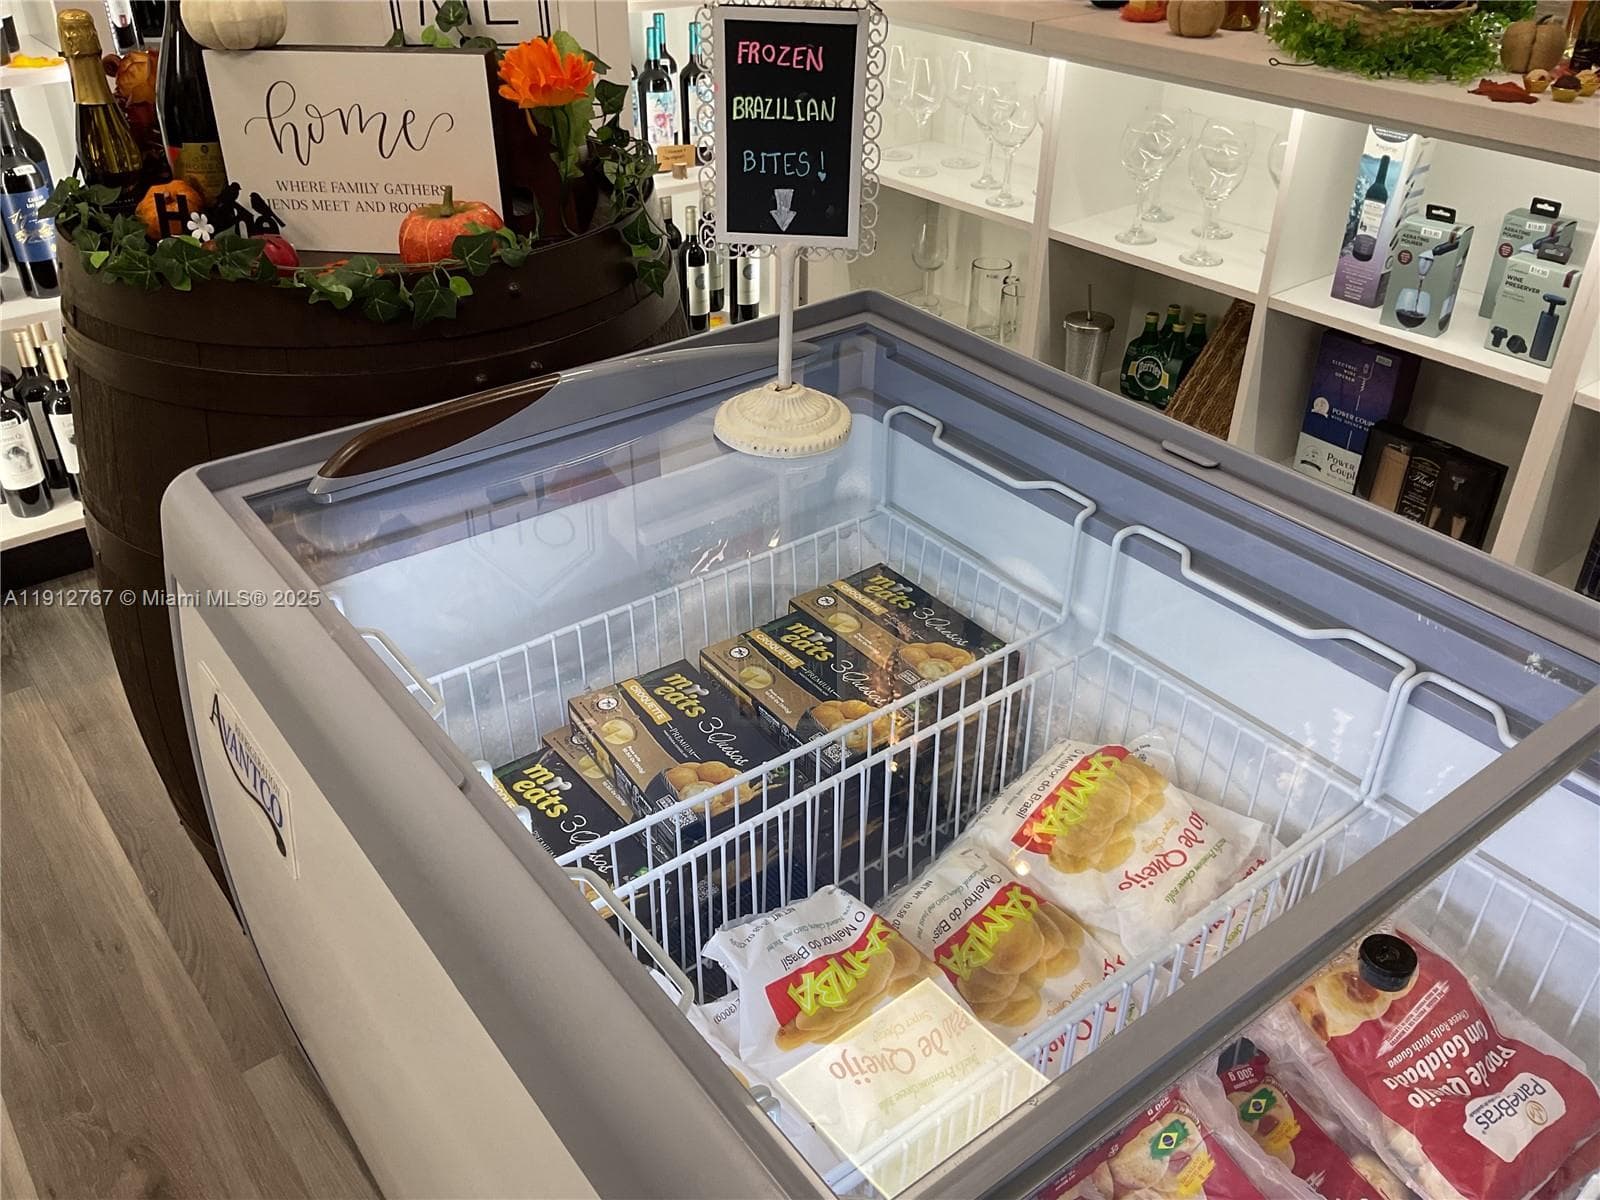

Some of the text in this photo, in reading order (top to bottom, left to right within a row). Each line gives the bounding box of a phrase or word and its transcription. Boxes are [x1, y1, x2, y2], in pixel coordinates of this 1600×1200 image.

[737, 40, 824, 72] FROZEN
[244, 80, 454, 165] home
[732, 95, 837, 123] BRAZILIAN
[275, 180, 326, 193] WHERE
[331, 181, 379, 194] FAMILY
[312, 199, 350, 212] MEET
[355, 201, 386, 213] AND
[755, 633, 800, 666] CROQUETTE
[780, 634, 836, 663] eats
[629, 684, 667, 723] CROQUETTE
[653, 685, 706, 718] eats
[839, 670, 883, 707] Quesos
[208, 692, 284, 829] AVANTCO
[706, 732, 749, 766] Quesos
[512, 779, 569, 818] eats
[1033, 752, 1121, 837] SAMBA
[1037, 780, 1051, 792] do
[1015, 793, 1042, 819] Brasil
[1118, 849, 1188, 891] Queijo
[957, 876, 998, 911] Melhor
[854, 911, 866, 922] O
[949, 906, 963, 921] do
[807, 940, 822, 950] do
[823, 924, 858, 946] Melhor
[938, 885, 1040, 982] SAMBA
[787, 918, 901, 1016] SAMBA
[918, 1027, 949, 1058] de
[1414, 1033, 1434, 1053] With
[1432, 1020, 1451, 1040] Rolls
[828, 1047, 916, 1086] Queijo
[1383, 1034, 1471, 1090] Goiabada
[1388, 1045, 1414, 1069] Guava
[1237, 1067, 1255, 1080] 300
[1465, 1062, 1490, 1088] de
